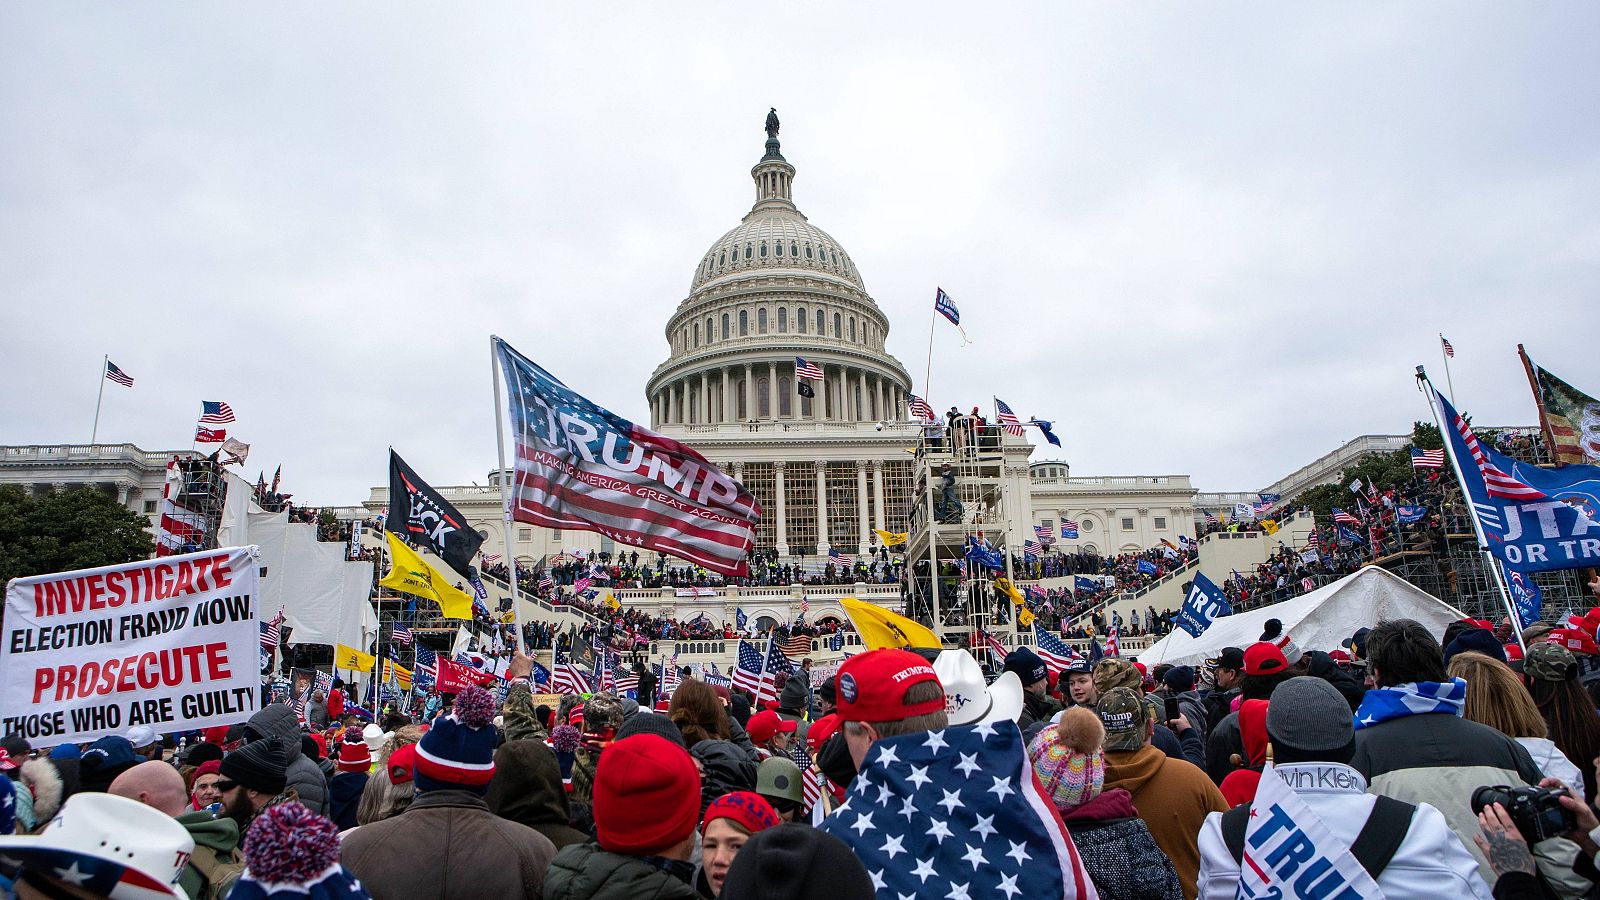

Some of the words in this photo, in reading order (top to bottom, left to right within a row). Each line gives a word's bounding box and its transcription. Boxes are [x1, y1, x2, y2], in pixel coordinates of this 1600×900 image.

[534, 395, 738, 506] TRUMP
[534, 451, 574, 476] MAKING
[576, 470, 632, 494] AMERICA
[635, 487, 687, 511] GREAT
[352, 521, 361, 557] TRUMP
[34, 554, 232, 617] INVESTIGATE
[10, 618, 113, 653] ELECTION
[119, 606, 190, 640] FRAUD
[32, 642, 232, 704] PROSECUTE
[705, 676, 732, 689] TRUMP
[3, 712, 66, 739] THOSE
[71, 704, 121, 733] WHO
[128, 698, 174, 727] ARE
[181, 686, 254, 719] GUILTY
[1101, 711, 1133, 721] Trump
[1317, 767, 1358, 790] Klein
